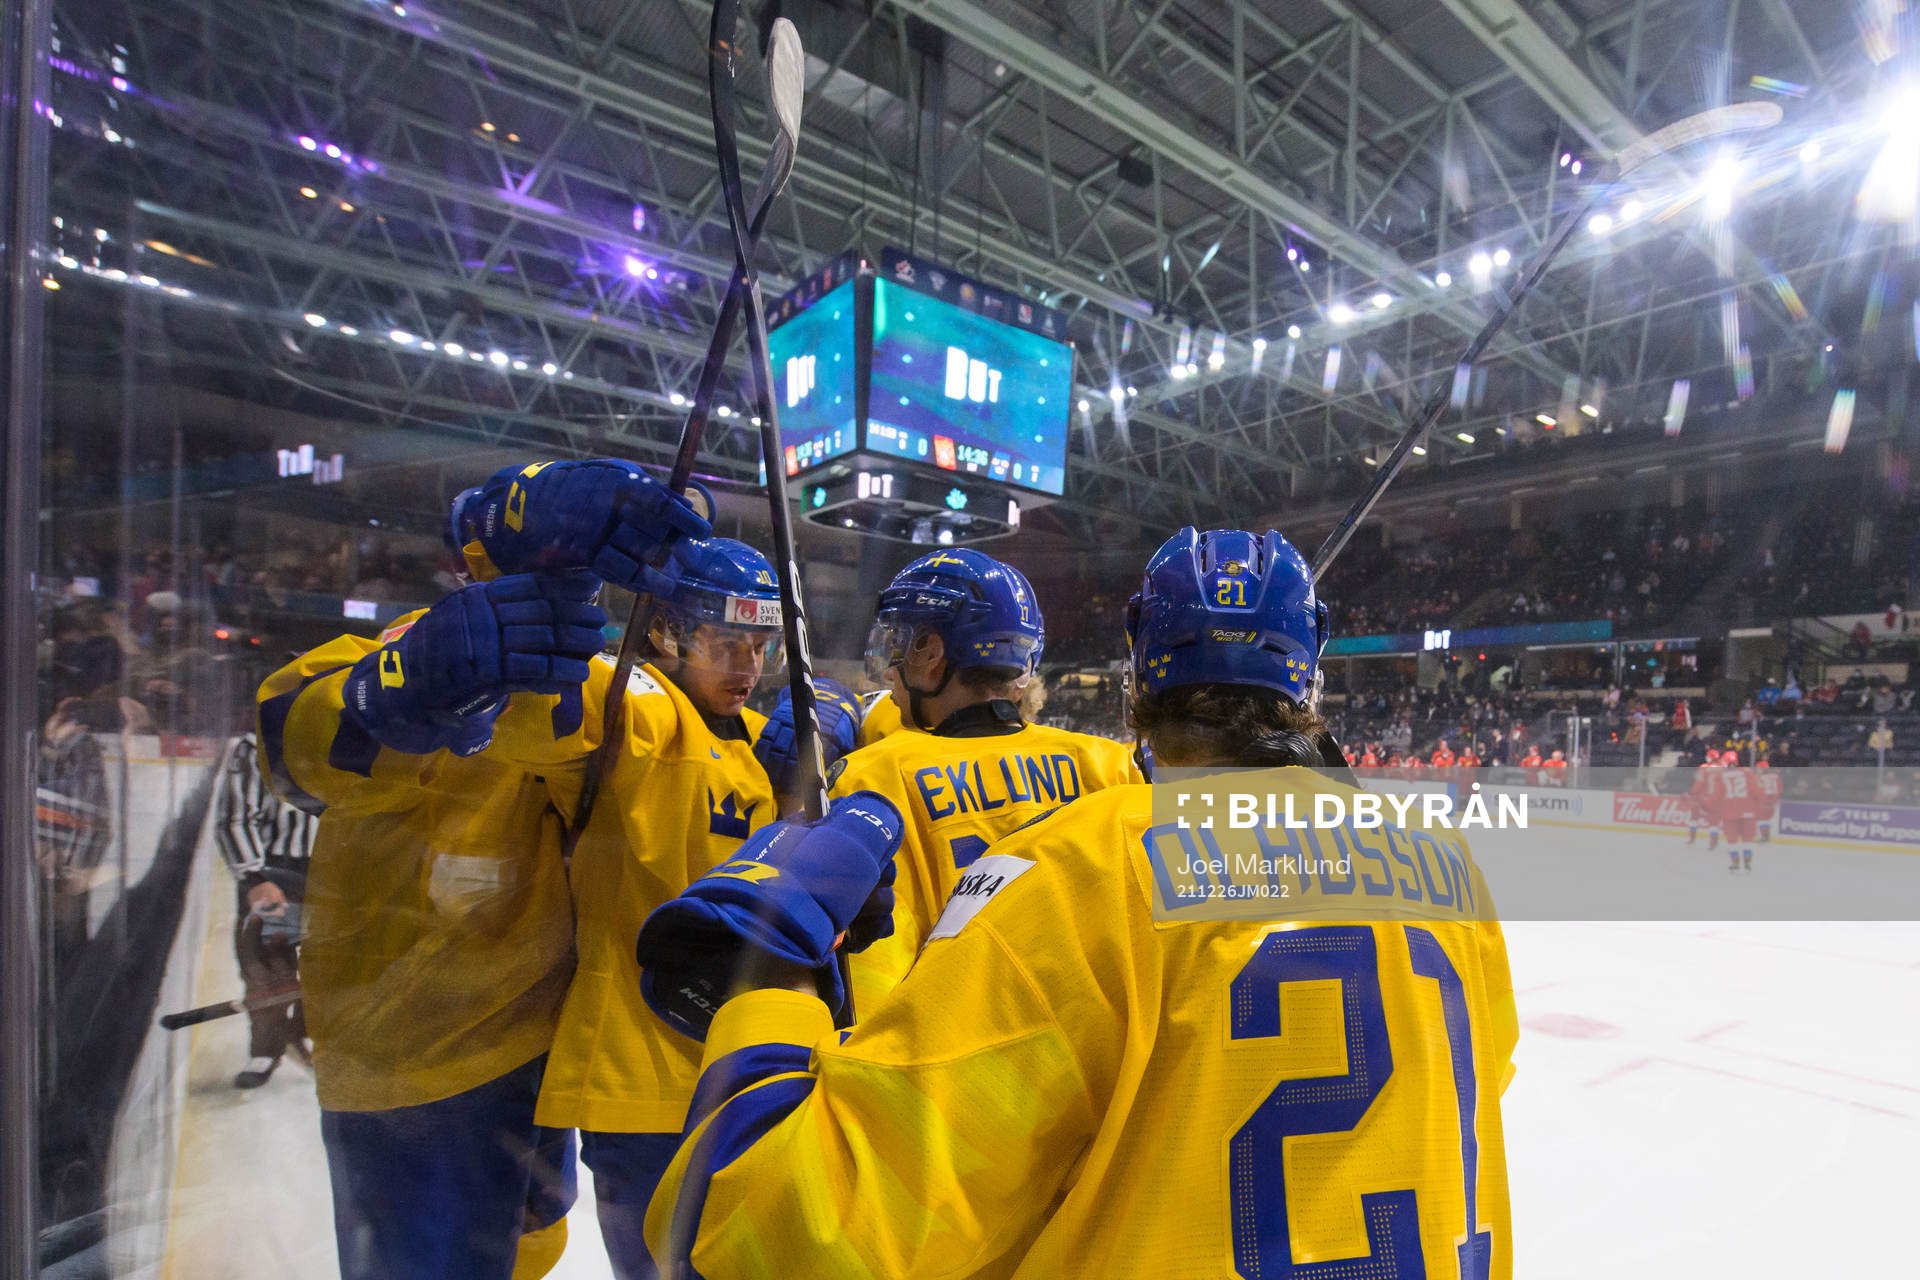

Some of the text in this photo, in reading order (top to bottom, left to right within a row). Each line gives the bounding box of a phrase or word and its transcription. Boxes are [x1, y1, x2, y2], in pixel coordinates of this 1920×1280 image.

[485, 503, 497, 538] SWEDEN
[1216, 579, 1247, 606] 21
[357, 680, 367, 711] SWEDEN
[914, 754, 1080, 821] EKLUND
[1617, 797, 1652, 822] Tim
[1844, 808, 1890, 822] TELUS
[846, 808, 893, 841] CCM
[1781, 817, 1847, 834] Powered
[1848, 822, 1868, 838] by
[951, 872, 1005, 896] NSKA
[1229, 925, 1493, 1280] 21
